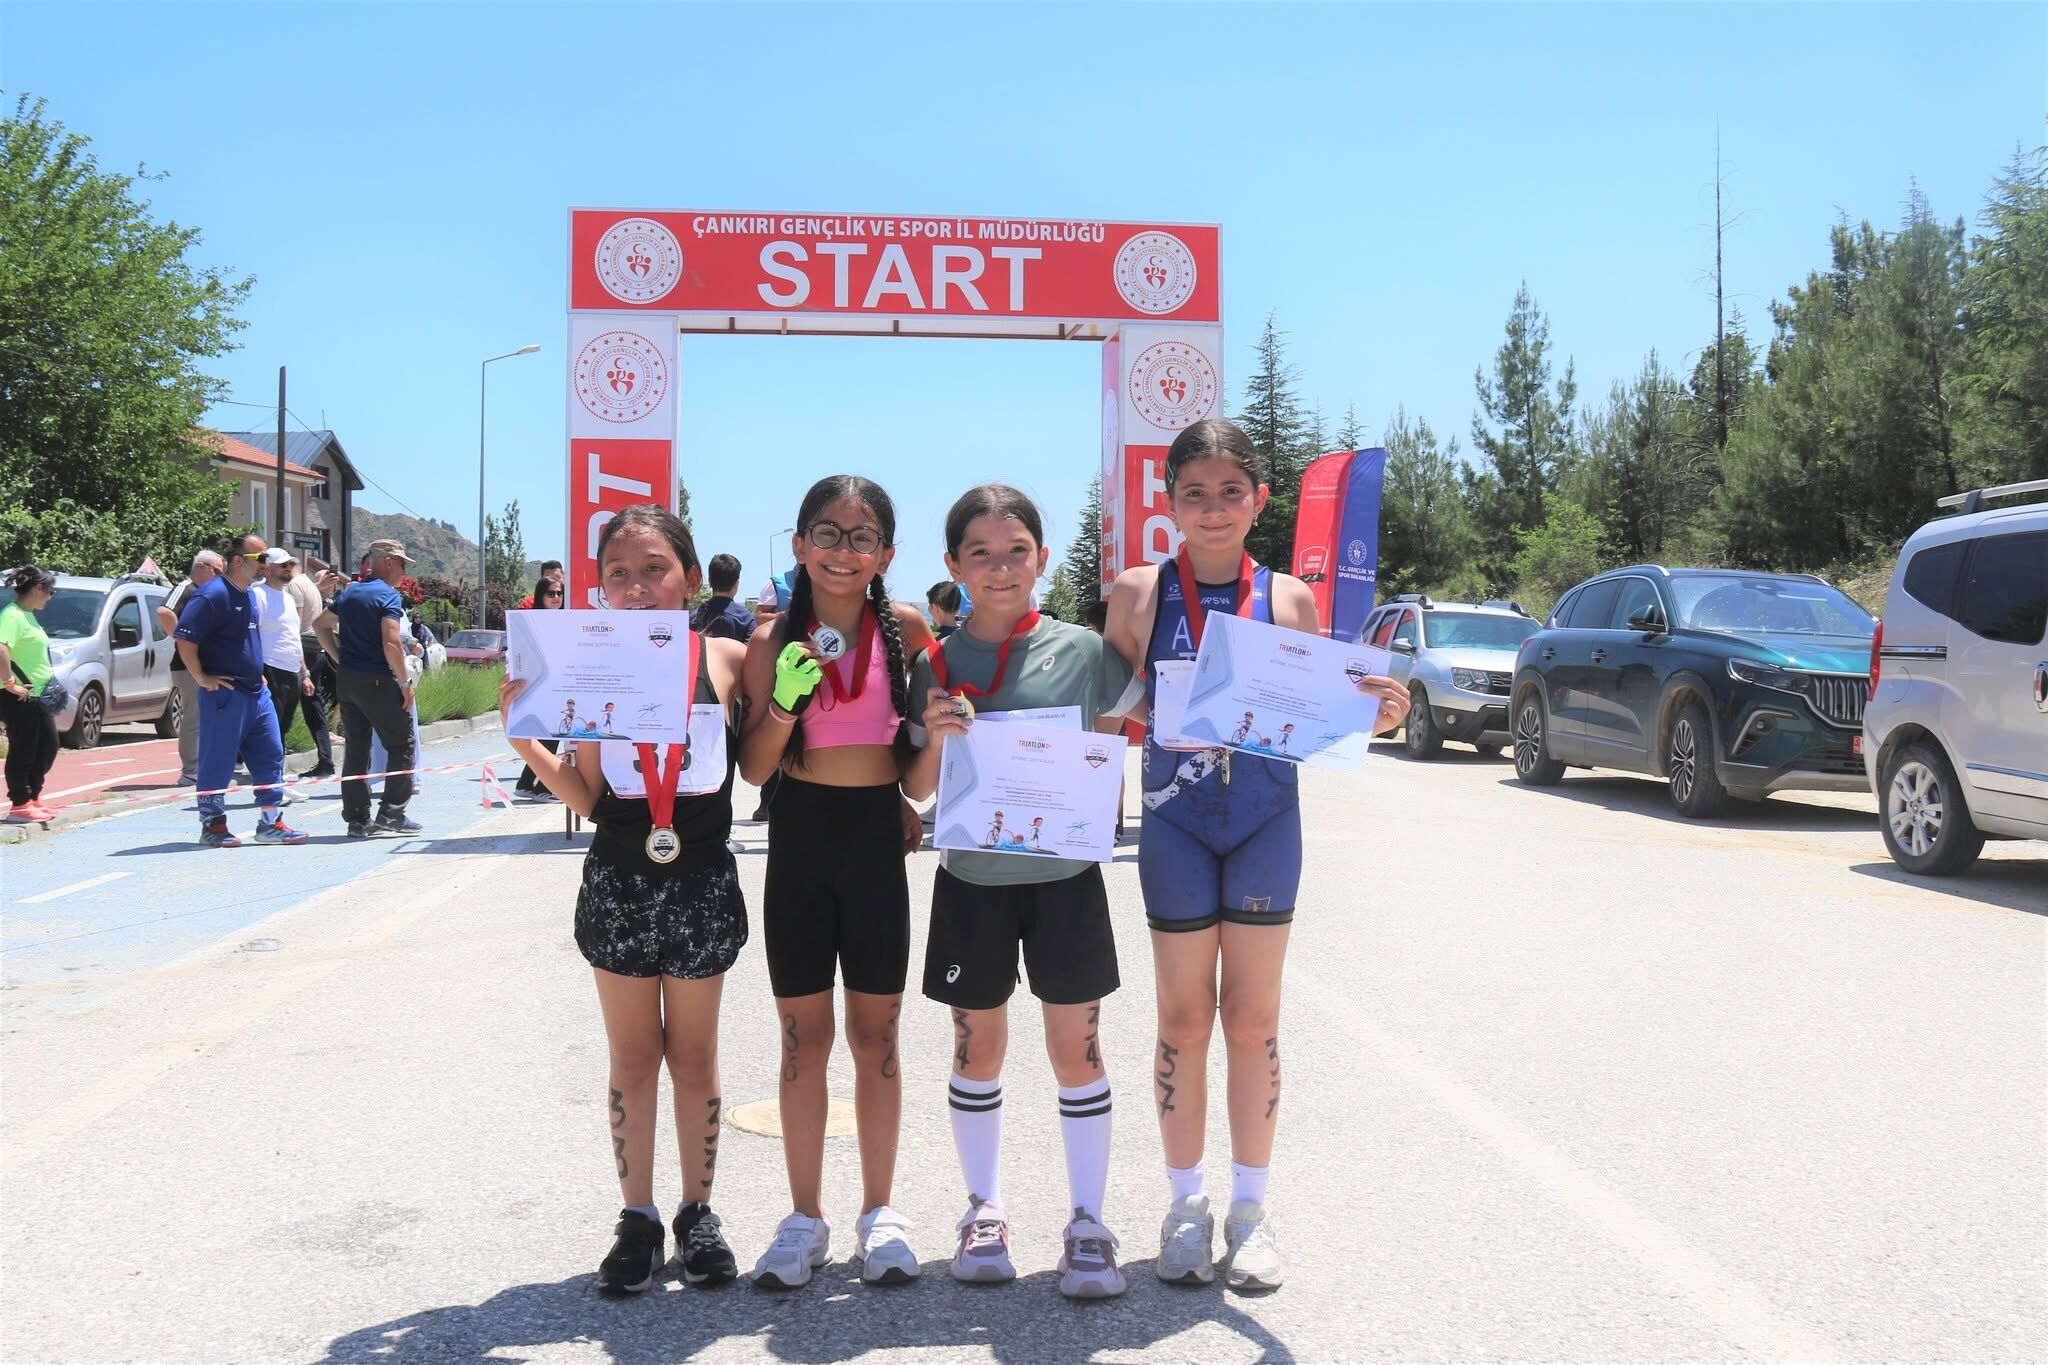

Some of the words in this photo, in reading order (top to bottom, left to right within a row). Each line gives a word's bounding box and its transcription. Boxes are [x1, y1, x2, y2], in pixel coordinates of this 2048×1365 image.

[692, 216, 775, 239] ÇANKIRI
[780, 217, 866, 240] GENÇLİK
[870, 220, 895, 237] VE
[900, 219, 952, 238] SPOR
[956, 219, 974, 239] İL
[978, 220, 1105, 243] MÜDÜRLÜĞÜ
[757, 240, 1043, 311] START
[582, 625, 609, 633] TRIATLON
[1279, 643, 1307, 656] TRIATLON
[1018, 740, 1046, 749] TRIATLON
[954, 1008, 973, 1070] 34
